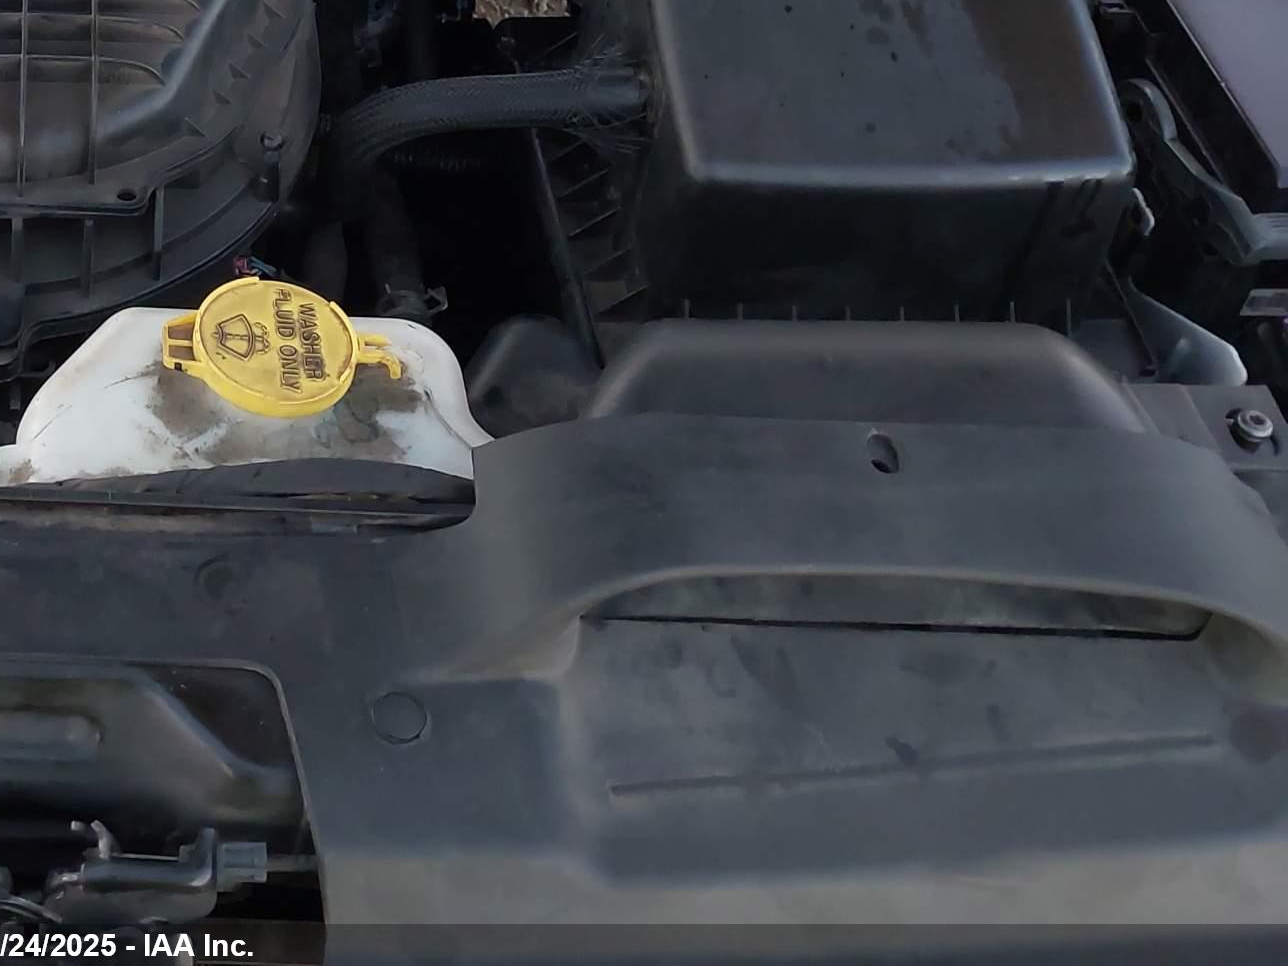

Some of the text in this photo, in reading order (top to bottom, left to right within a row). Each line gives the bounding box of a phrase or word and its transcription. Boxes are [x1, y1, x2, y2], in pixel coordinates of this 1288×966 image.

[272, 288, 303, 394] FLUID ONLY
[298, 302, 324, 381] WASHER
